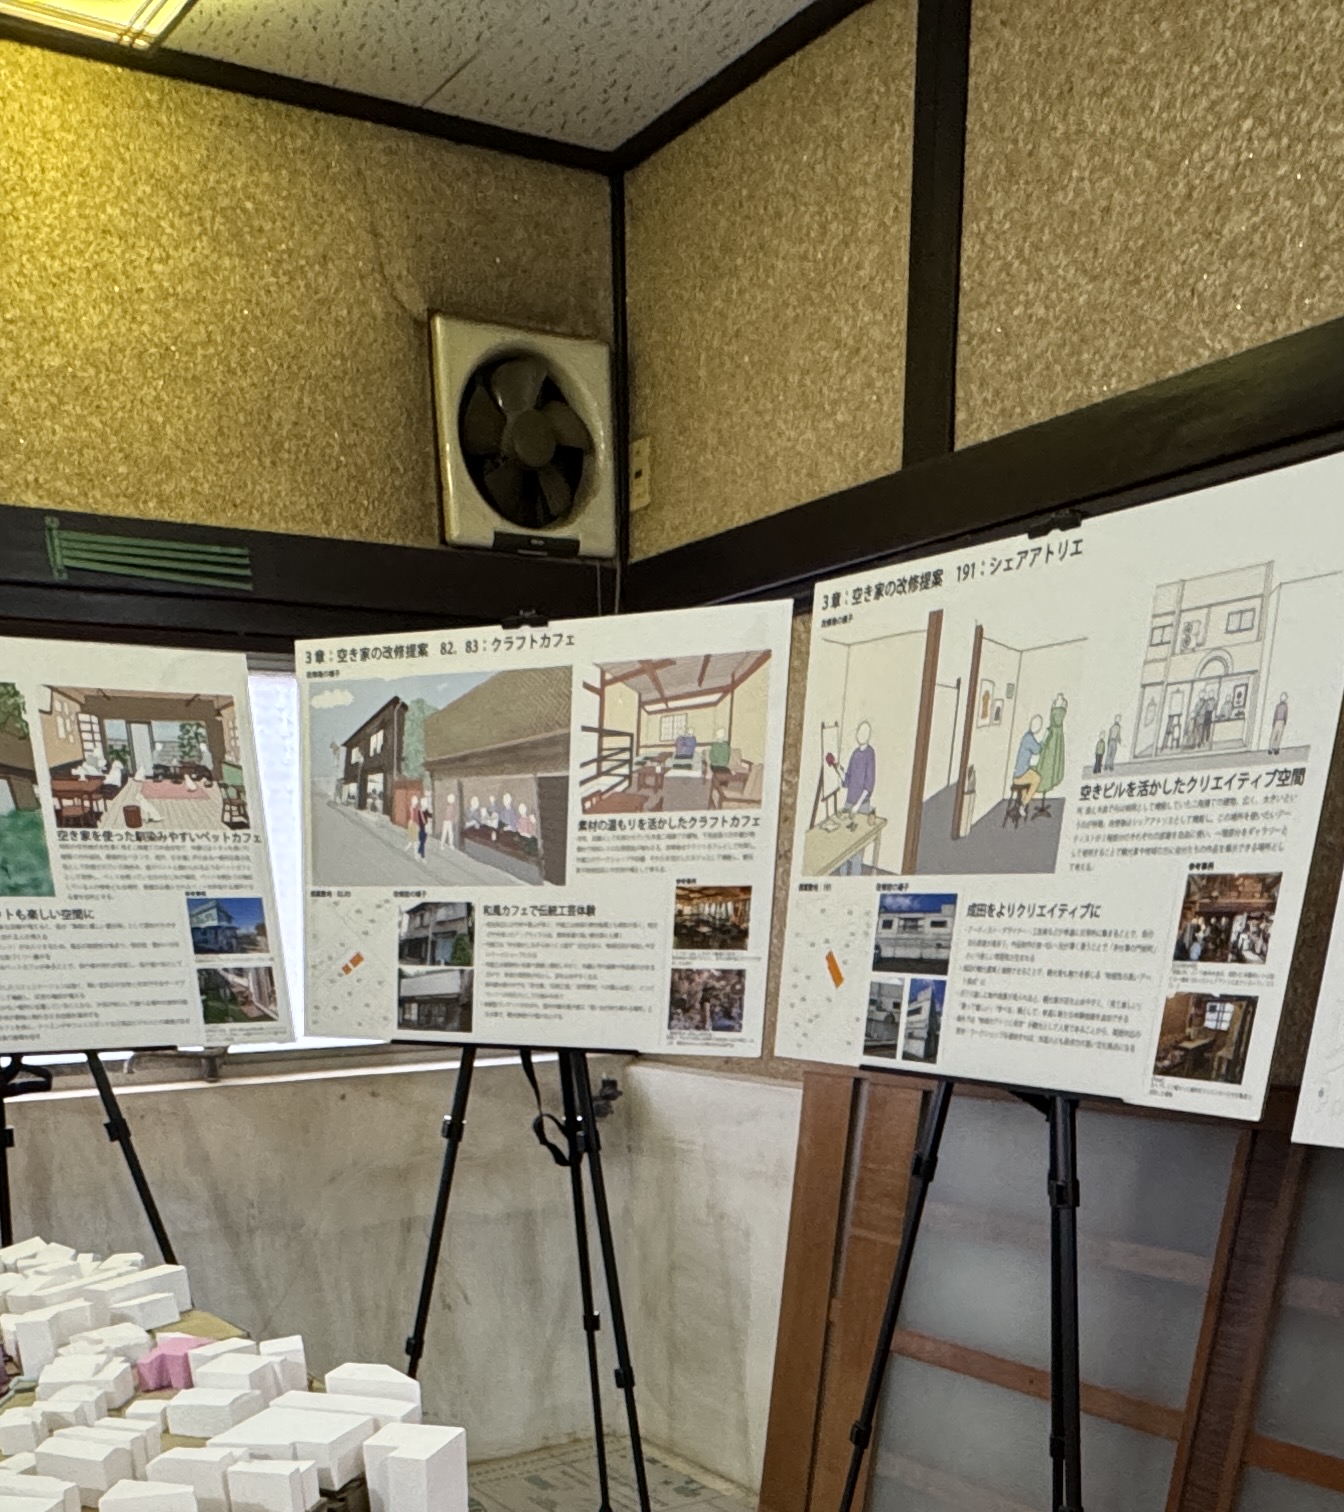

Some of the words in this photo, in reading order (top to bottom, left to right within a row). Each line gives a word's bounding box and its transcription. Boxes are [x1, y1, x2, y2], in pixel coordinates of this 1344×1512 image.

[1078, 767, 1307, 801] 空きビルを活かしたクリエイティブ空間
[966, 902, 1102, 919] 成田をよりクリエイティブに
